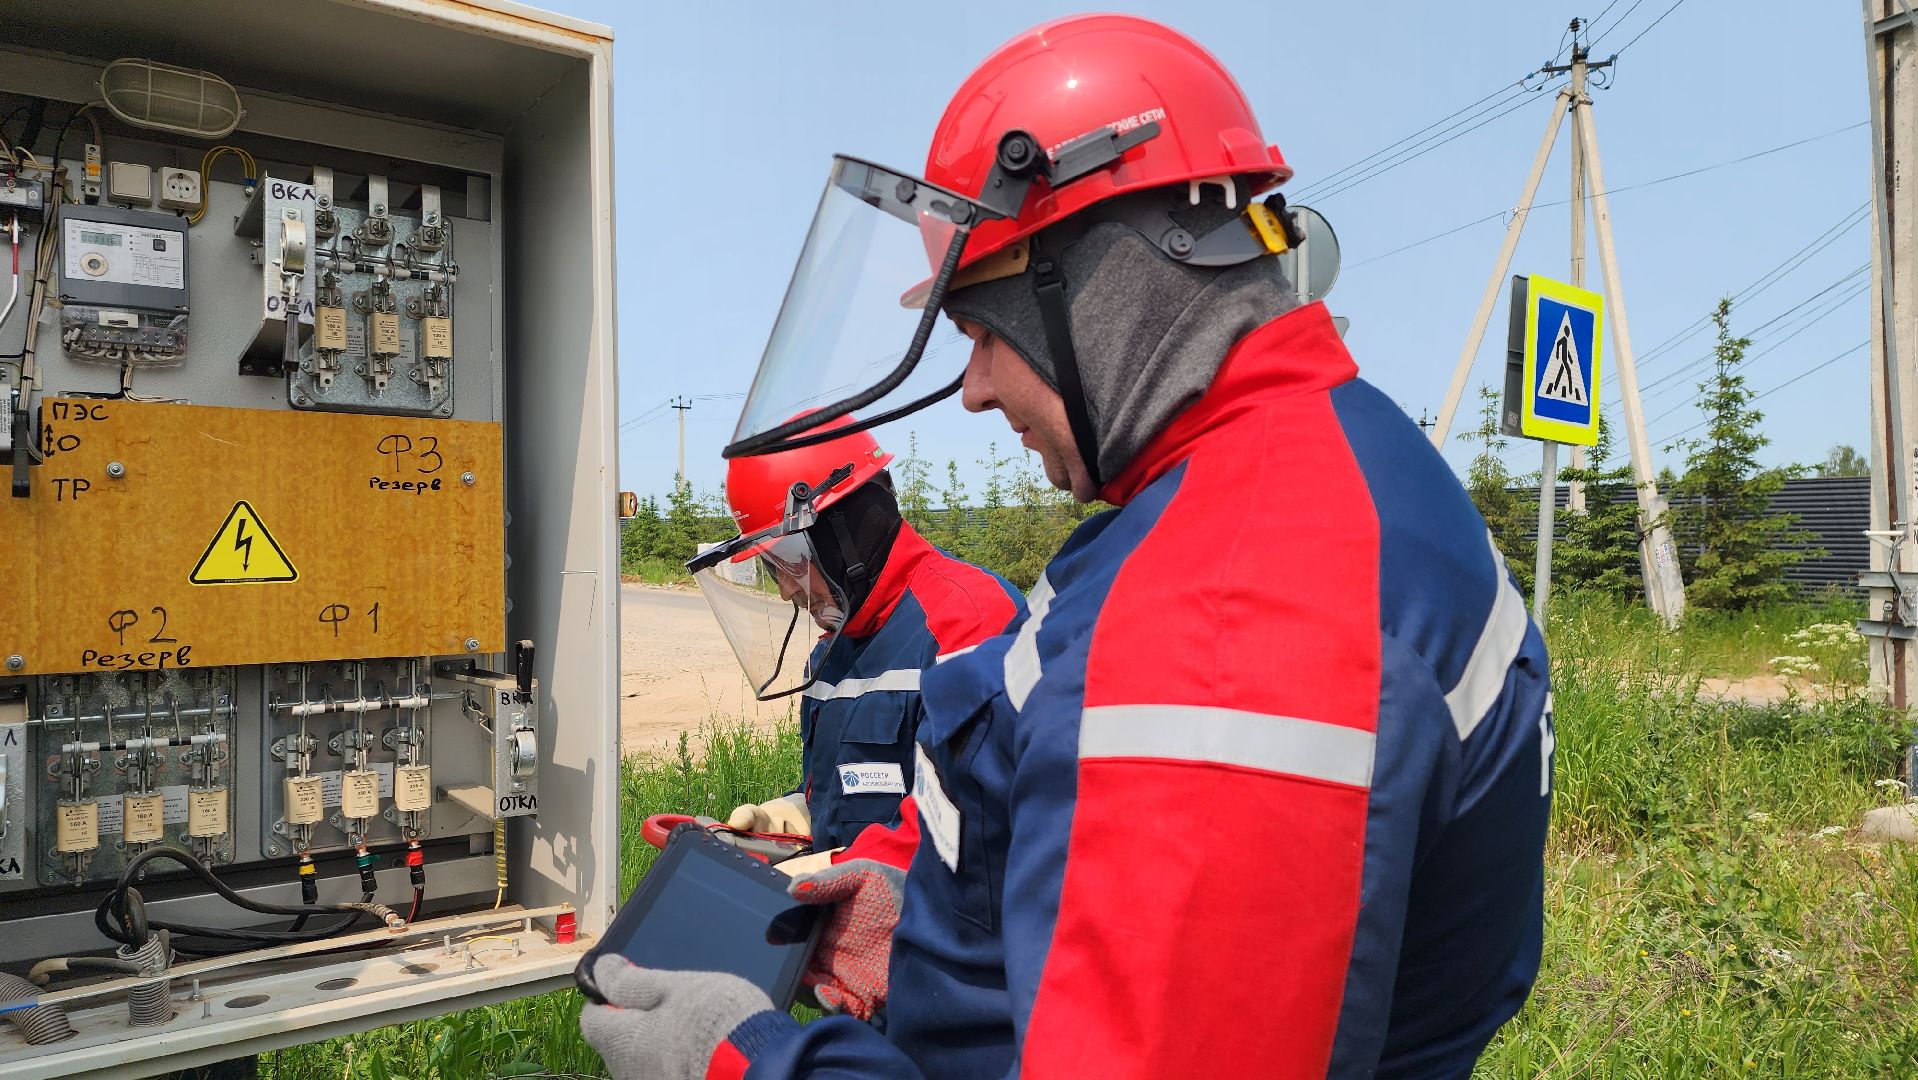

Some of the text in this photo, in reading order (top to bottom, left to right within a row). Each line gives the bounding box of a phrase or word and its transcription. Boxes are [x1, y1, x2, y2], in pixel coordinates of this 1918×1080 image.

[271, 182, 317, 201] ВКЛ
[52, 401, 109, 421] ПЭС
[51, 478, 91, 502] ТР
[369, 476, 442, 496] Резерв
[82, 645, 192, 669] Резерв
[499, 795, 538, 812] ОТКЛ
